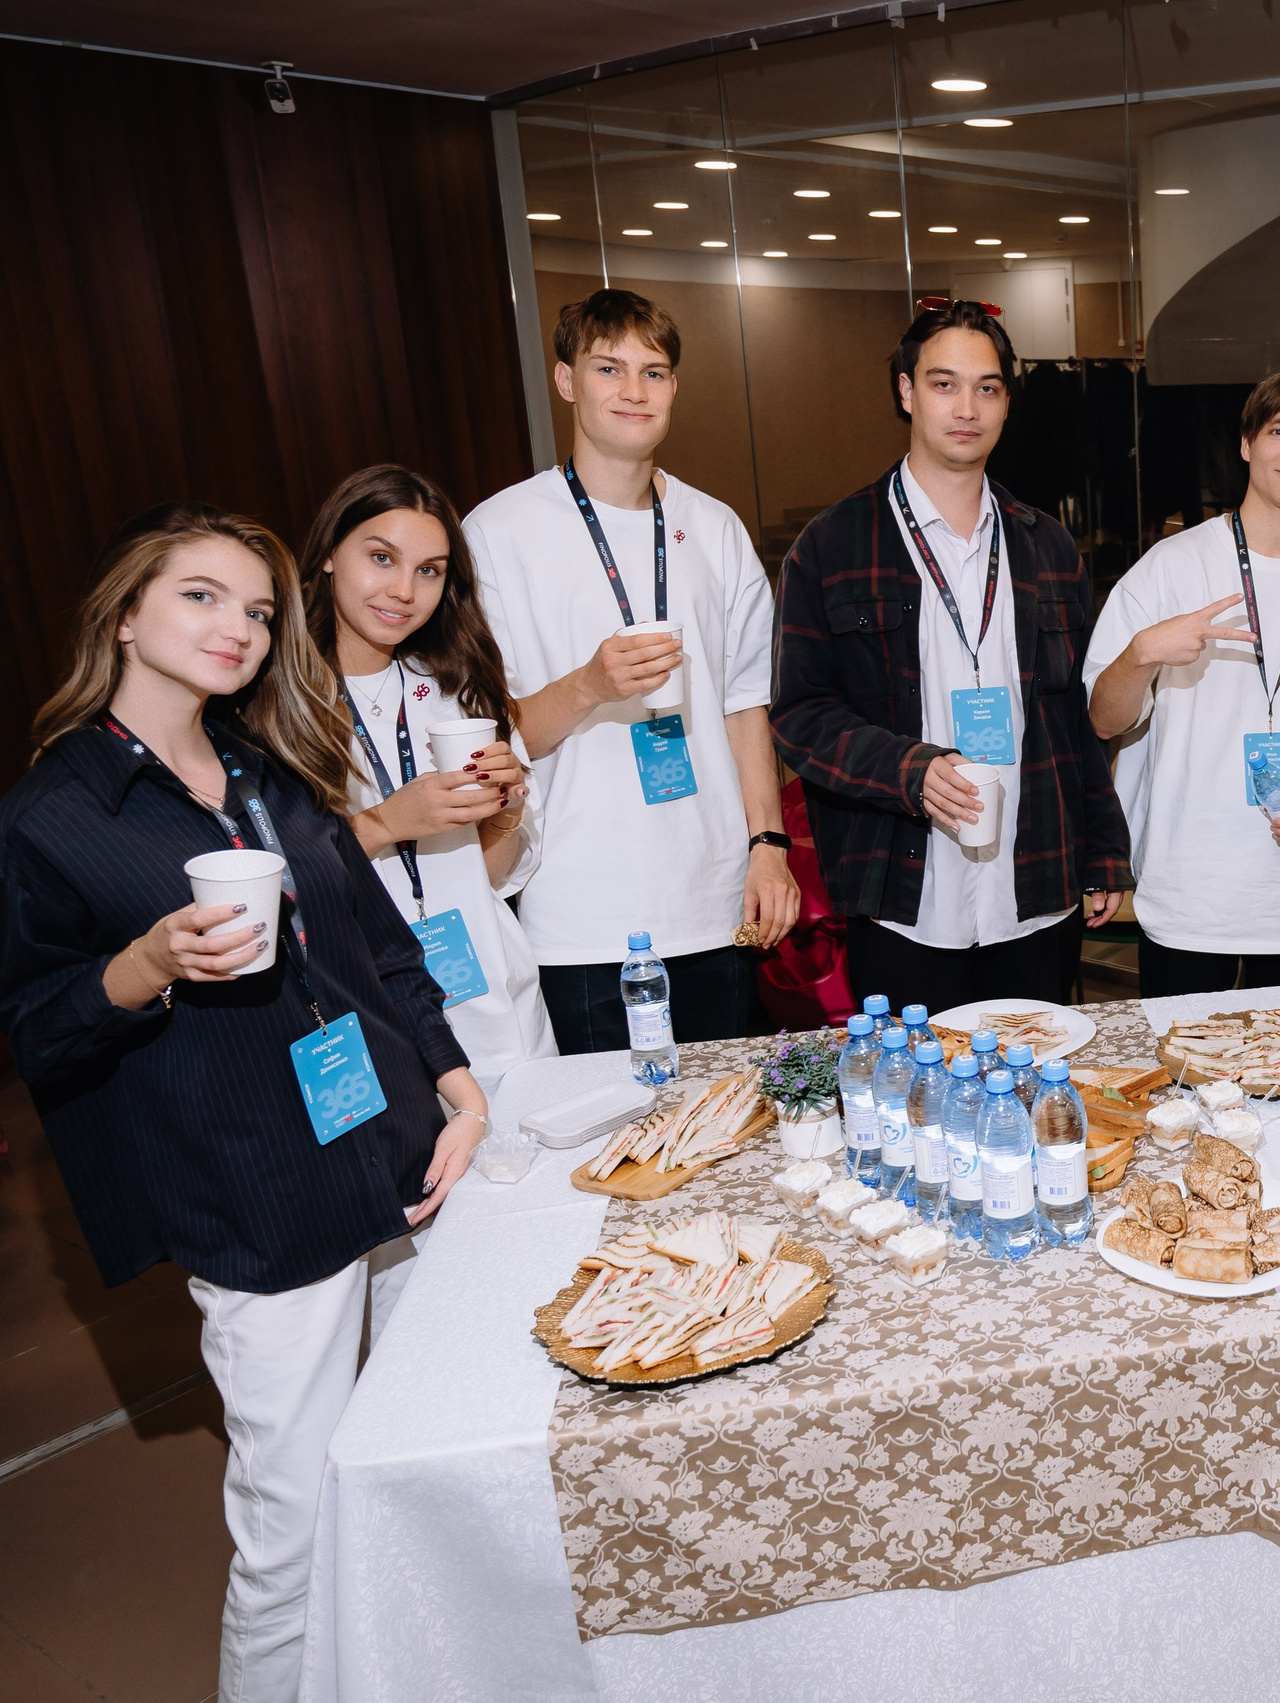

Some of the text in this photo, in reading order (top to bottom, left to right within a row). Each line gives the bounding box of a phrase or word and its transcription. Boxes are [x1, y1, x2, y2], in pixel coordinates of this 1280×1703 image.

[598, 542, 612, 567] FINOPOLIS
[413, 683, 430, 701] 365
[645, 727, 671, 738] УЧАСТНИК
[963, 726, 1006, 752] 365
[361, 737, 378, 763] FINOPOLIS
[646, 757, 687, 788] 365
[248, 798, 274, 845] FINOPOLIS 365
[434, 957, 473, 989] 65
[311, 1033, 345, 1055] УЧАСТНИК
[320, 1056, 348, 1076] Денисенко
[323, 1052, 341, 1064] София
[318, 1070, 371, 1119] 365
